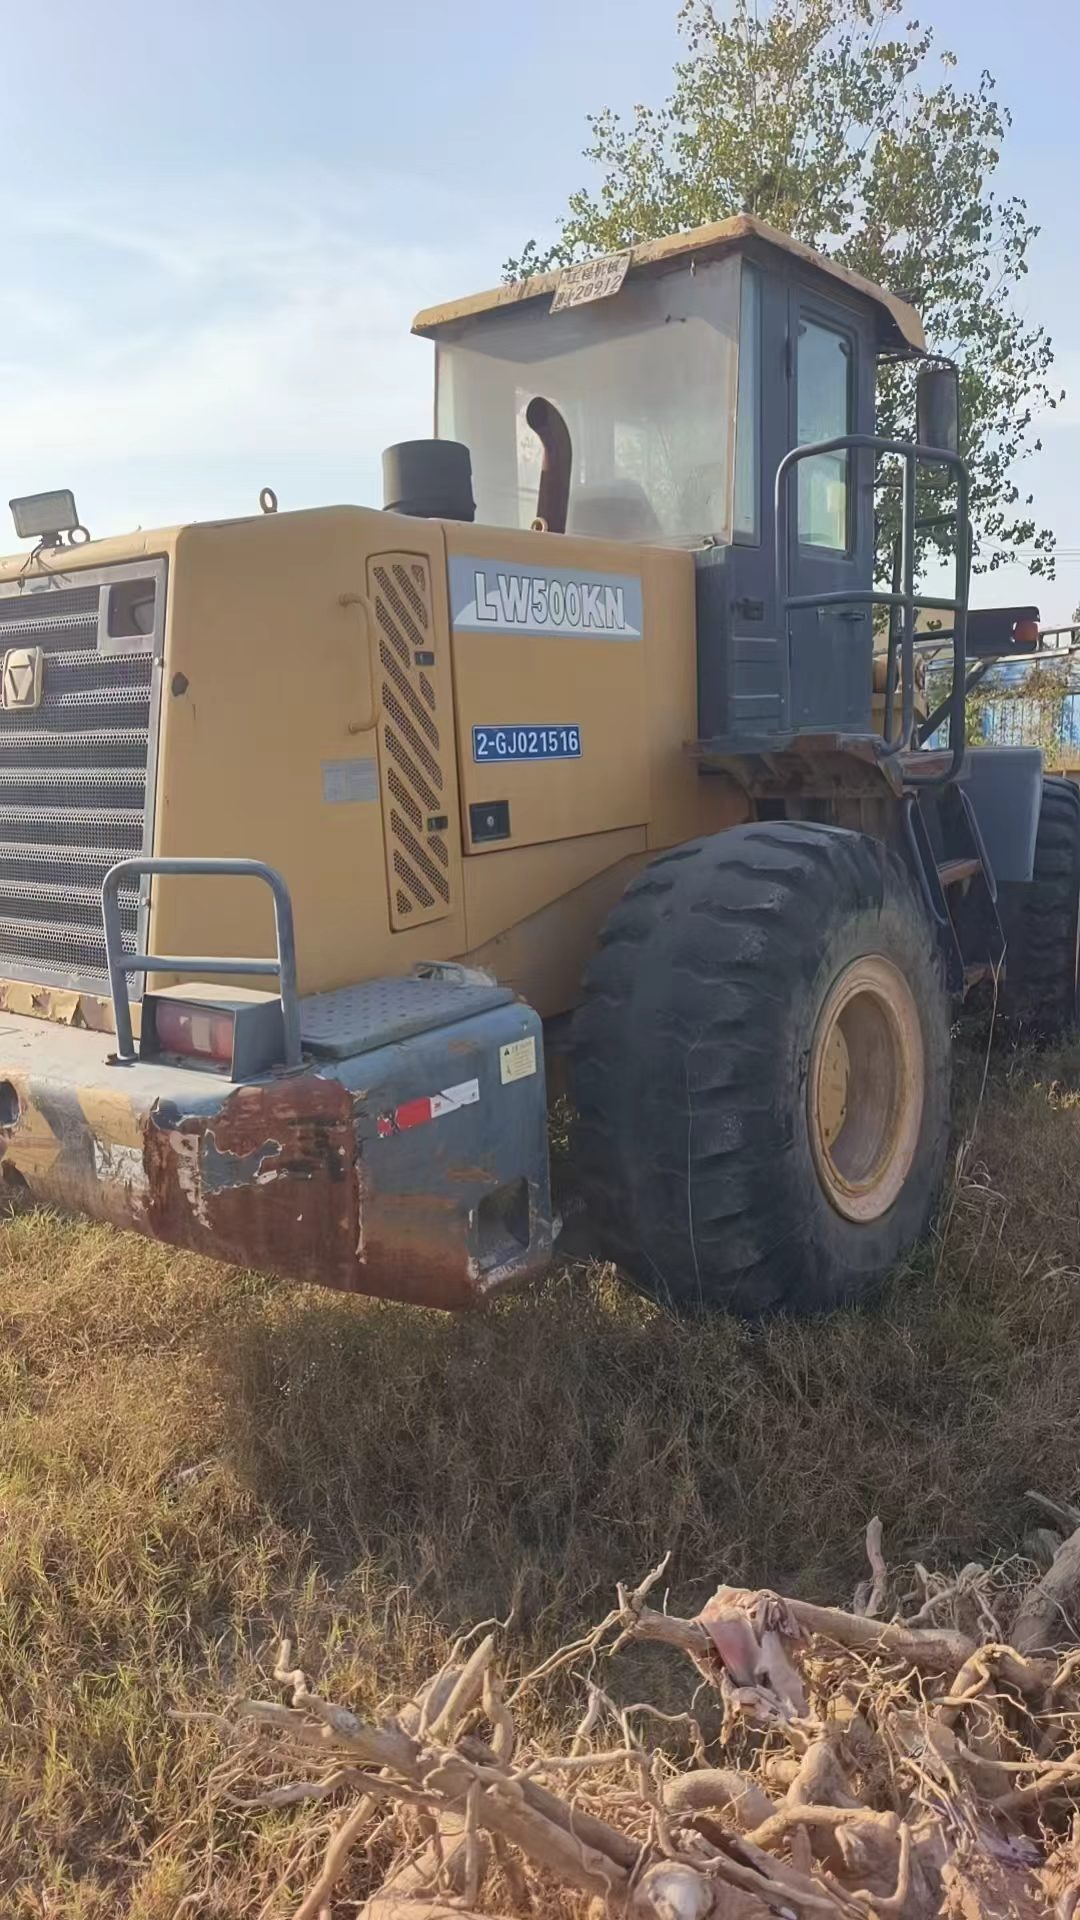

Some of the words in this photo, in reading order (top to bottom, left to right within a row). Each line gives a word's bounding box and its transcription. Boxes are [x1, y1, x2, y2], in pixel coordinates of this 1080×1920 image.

[566, 260, 618, 284] 工程机械
[474, 571, 626, 630] LW500KN
[477, 730, 578, 755] 2-GJ021516
